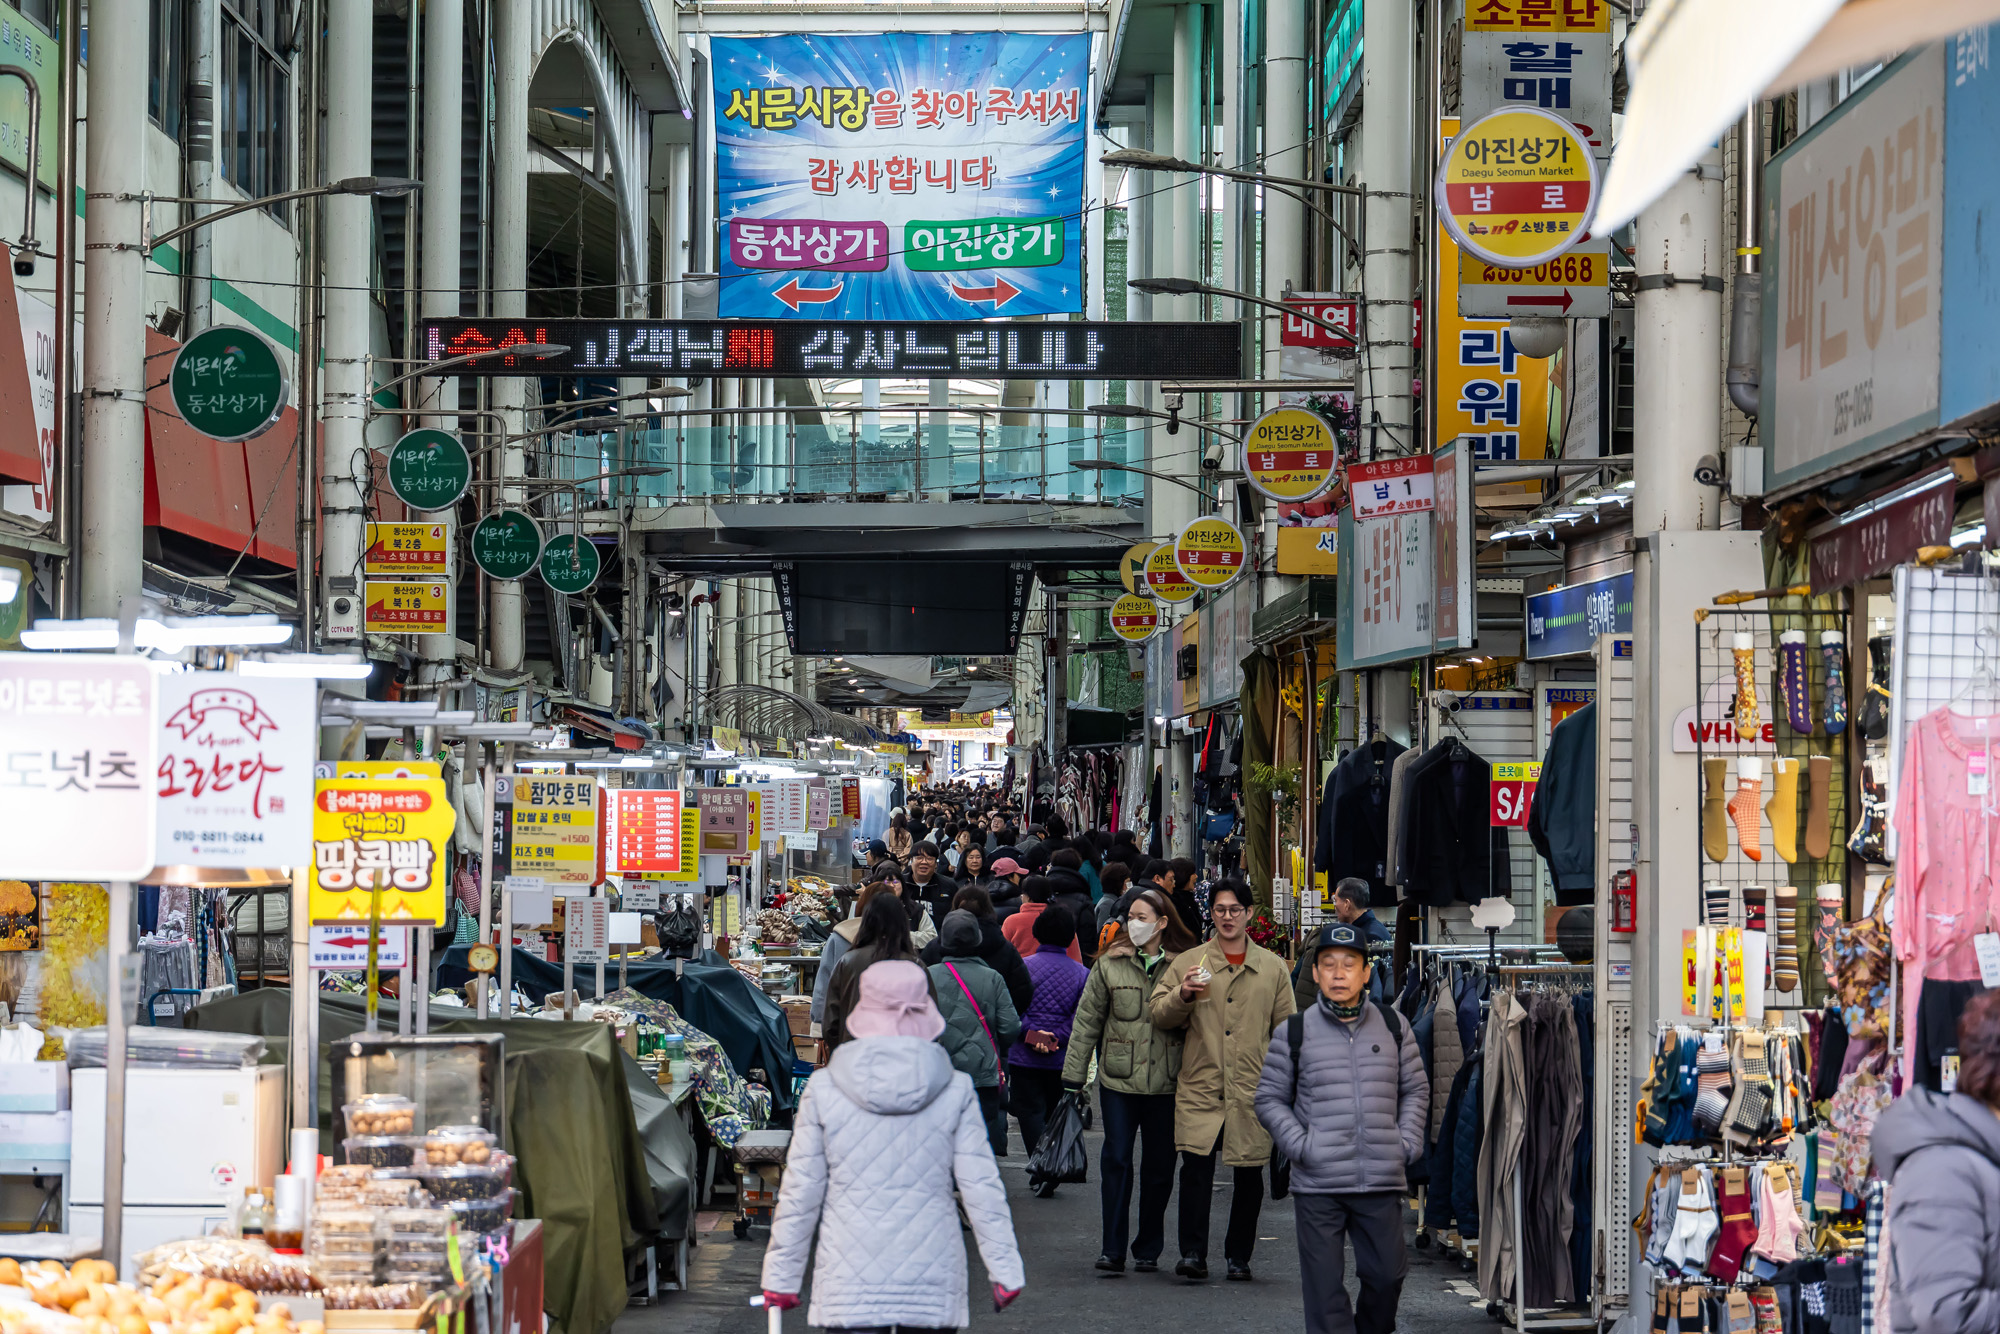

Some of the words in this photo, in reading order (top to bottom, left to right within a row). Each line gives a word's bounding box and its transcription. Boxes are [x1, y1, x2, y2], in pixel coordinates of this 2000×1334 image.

[725, 86, 903, 130] 서문시장을
[911, 88, 978, 129] 찾아
[985, 86, 1080, 125] 주셔서
[1465, 137, 1570, 164] 아진상가
[808, 154, 996, 195] 감사합니다
[1462, 168, 1494, 178] Daegu
[1497, 167, 1535, 176] Seomun
[1539, 167, 1574, 176] Market
[1470, 185, 1494, 211] 남
[1541, 185, 1566, 209] 로
[1490, 219, 1519, 235] 119
[1521, 221, 1570, 233] 소방통로
[736, 224, 880, 262] 동산상가
[912, 222, 1057, 262] 아진상가
[1785, 105, 1937, 381] 패션양말
[187, 394, 267, 414] 동산상가
[1258, 424, 1321, 441] 아진상가
[1261, 453, 1276, 469] 남
[1304, 453, 1319, 468] 로
[1366, 459, 1418, 475] 아진상가
[400, 477, 458, 492] 동산상가
[1292, 474, 1321, 482] 소방통로
[1374, 481, 1390, 500] 남
[1403, 478, 1411, 495] 1
[1397, 499, 1432, 510] 소방통로
[393, 527, 424, 535] 동산상가
[432, 527, 440, 537] 4
[1187, 530, 1235, 543] 아진상가
[1317, 531, 1335, 553] 서
[389, 552, 417, 561] 소방대
[423, 552, 441, 561] 통로
[482, 551, 531, 564] 동산상가
[1154, 555, 1174, 565] 아진
[1188, 552, 1200, 563] 남
[1220, 552, 1232, 564] 로
[1010, 562, 1032, 570] 서문시장
[549, 569, 591, 580] 동산상가
[1156, 573, 1166, 583] 남
[393, 587, 424, 595] 동산상가
[433, 587, 440, 597] 3
[1014, 573, 1024, 607] 만남의
[1117, 602, 1151, 611] 아진상가
[389, 612, 417, 620] 소방대
[423, 612, 441, 620] 통로
[786, 611, 794, 632] 장소
[1010, 611, 1020, 632] 장소
[2, 750, 141, 792] 도넛츠
[1498, 766, 1514, 777] 큰옷
[498, 781, 506, 792] 3
[531, 782, 591, 806] 참맛호떡
[701, 793, 743, 805] 할매호떡
[517, 812, 537, 822] 찹쌀
[552, 812, 571, 823] 호떡
[494, 810, 504, 854] 먹거리
[514, 846, 532, 857] 치즈
[536, 847, 554, 857] 호떡
[315, 838, 436, 892] 땅콩빵
